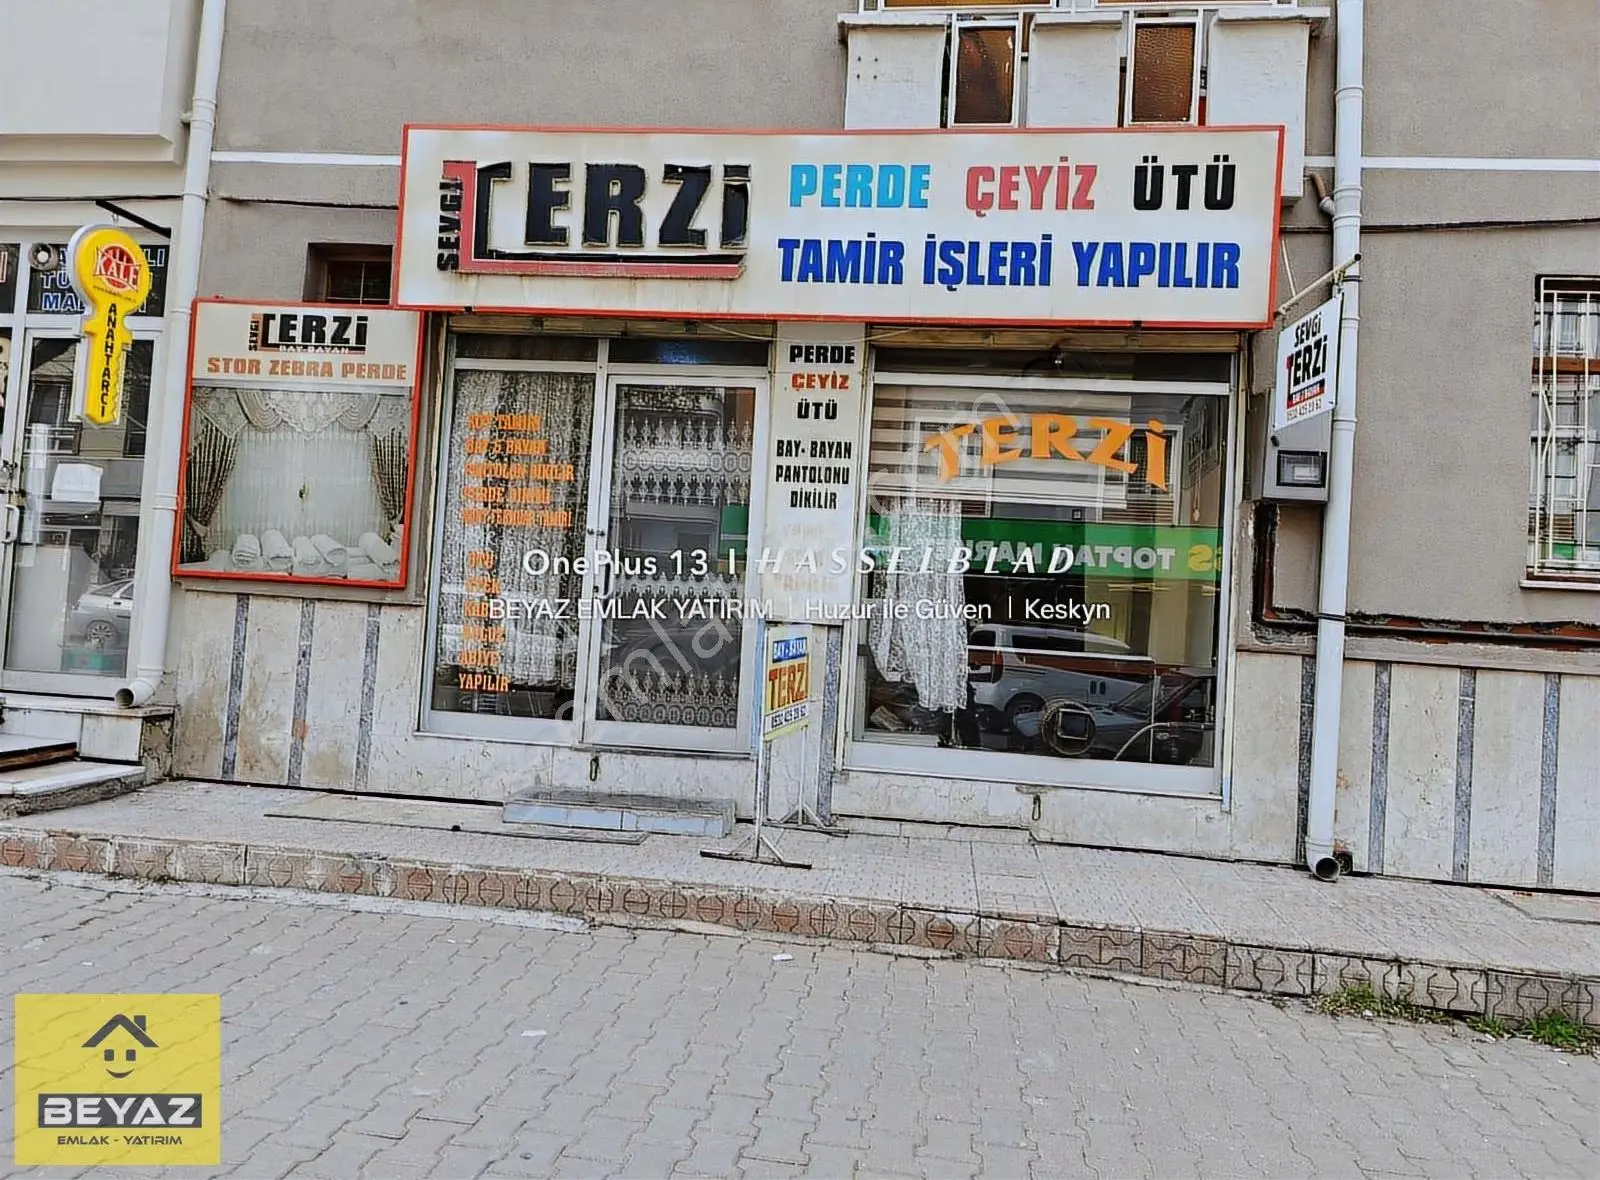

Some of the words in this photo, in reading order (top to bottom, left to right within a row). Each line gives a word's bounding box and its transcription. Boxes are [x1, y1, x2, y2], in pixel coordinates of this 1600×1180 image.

[789, 163, 931, 210] PERDE
[966, 156, 1098, 218] ÇEYİZ
[1134, 154, 1237, 211] ÜTÜ
[778, 232, 905, 284] TAMİR
[923, 233, 1053, 292] İŞLERİ
[1072, 240, 1241, 289] YAPILIR
[100, 303, 117, 418] ANAHTARCI
[789, 344, 856, 364] PERDE
[207, 357, 261, 376] STOR
[268, 359, 334, 378] ZEBRA
[341, 362, 407, 381] PERDE
[791, 371, 850, 392] ÇEYİZ
[797, 399, 837, 421] ÜTÜ
[810, 440, 852, 459] BAYAN
[775, 465, 850, 485] PANTOLONU
[790, 488, 838, 510] DİKİLİR
